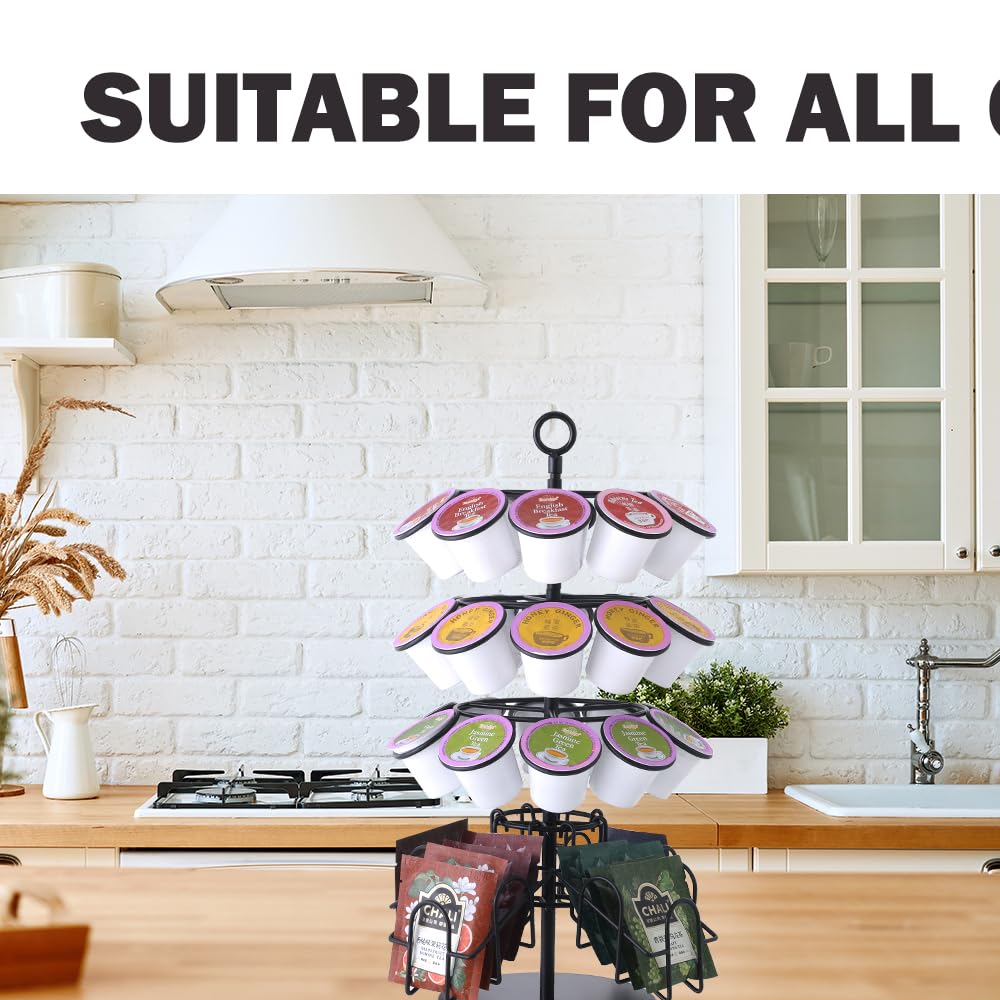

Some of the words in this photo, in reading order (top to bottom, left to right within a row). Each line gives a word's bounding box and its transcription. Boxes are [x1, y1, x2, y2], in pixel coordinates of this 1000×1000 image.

[536, 502, 564, 510] English
[554, 608, 582, 629] GINGER
[550, 731, 580, 744] Jasmine
[552, 738, 575, 748] Green
[642, 901, 670, 916] CHALI
